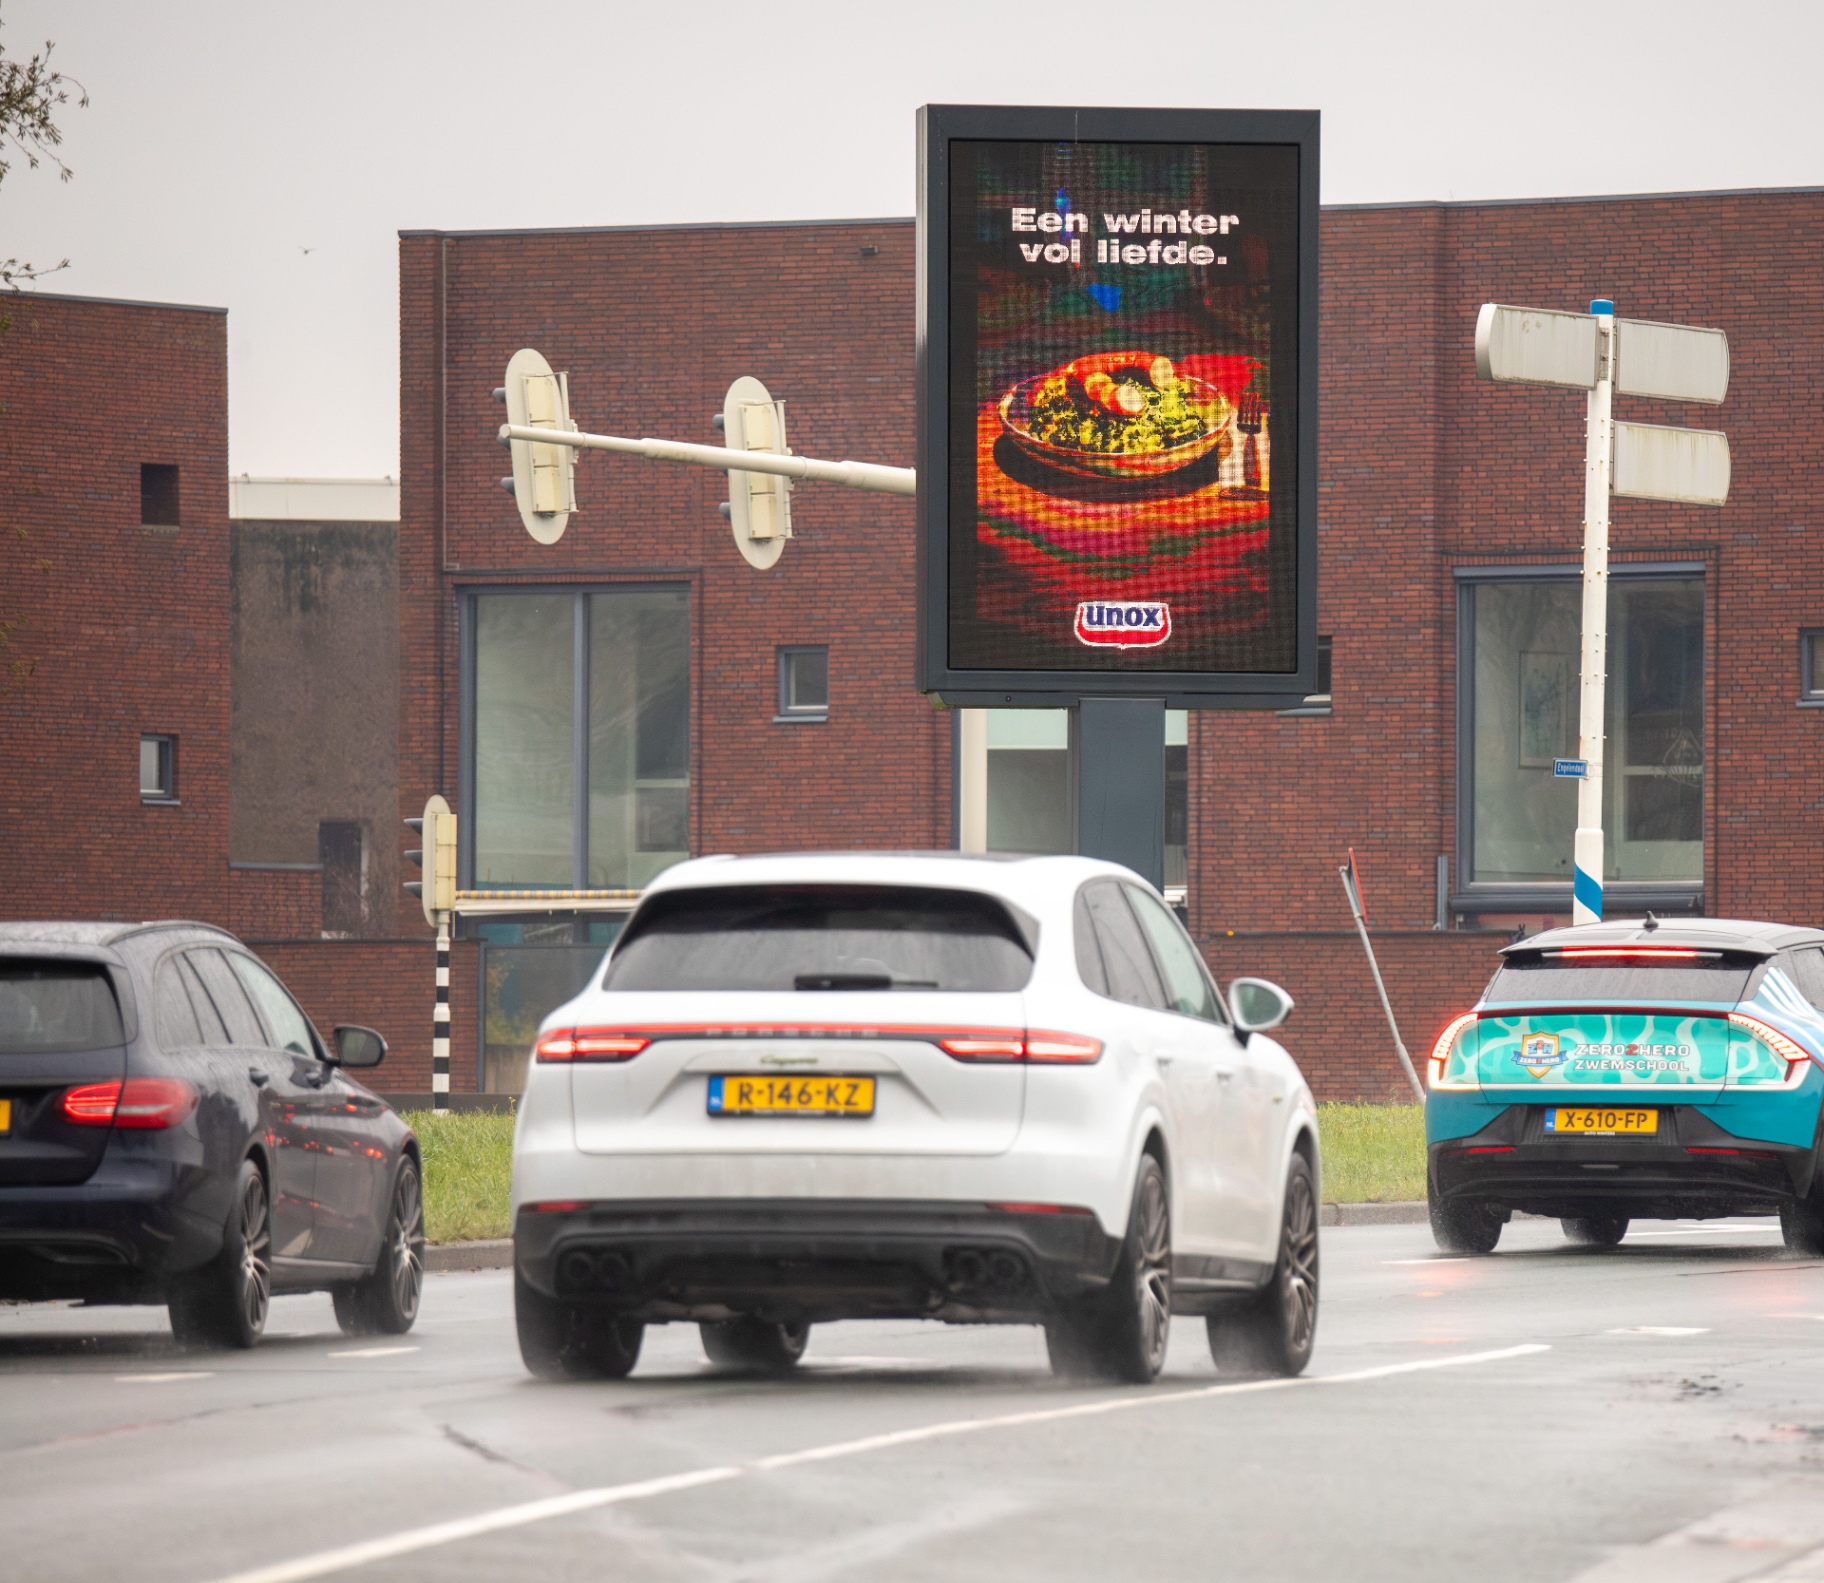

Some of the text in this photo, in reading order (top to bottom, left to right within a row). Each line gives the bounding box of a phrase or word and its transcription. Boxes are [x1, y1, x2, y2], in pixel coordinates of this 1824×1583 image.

[1012, 207, 1240, 235] Een winter
[1019, 239, 1227, 265] vol liefde.
[1086, 605, 1161, 627] unox
[1574, 1043, 1690, 1056] ZERO2HERO
[1573, 1059, 1690, 1071] ZWEMSCHOOL
[737, 1081, 861, 1106] R-146-KZ
[1564, 1111, 1648, 1128] X-610-FP
